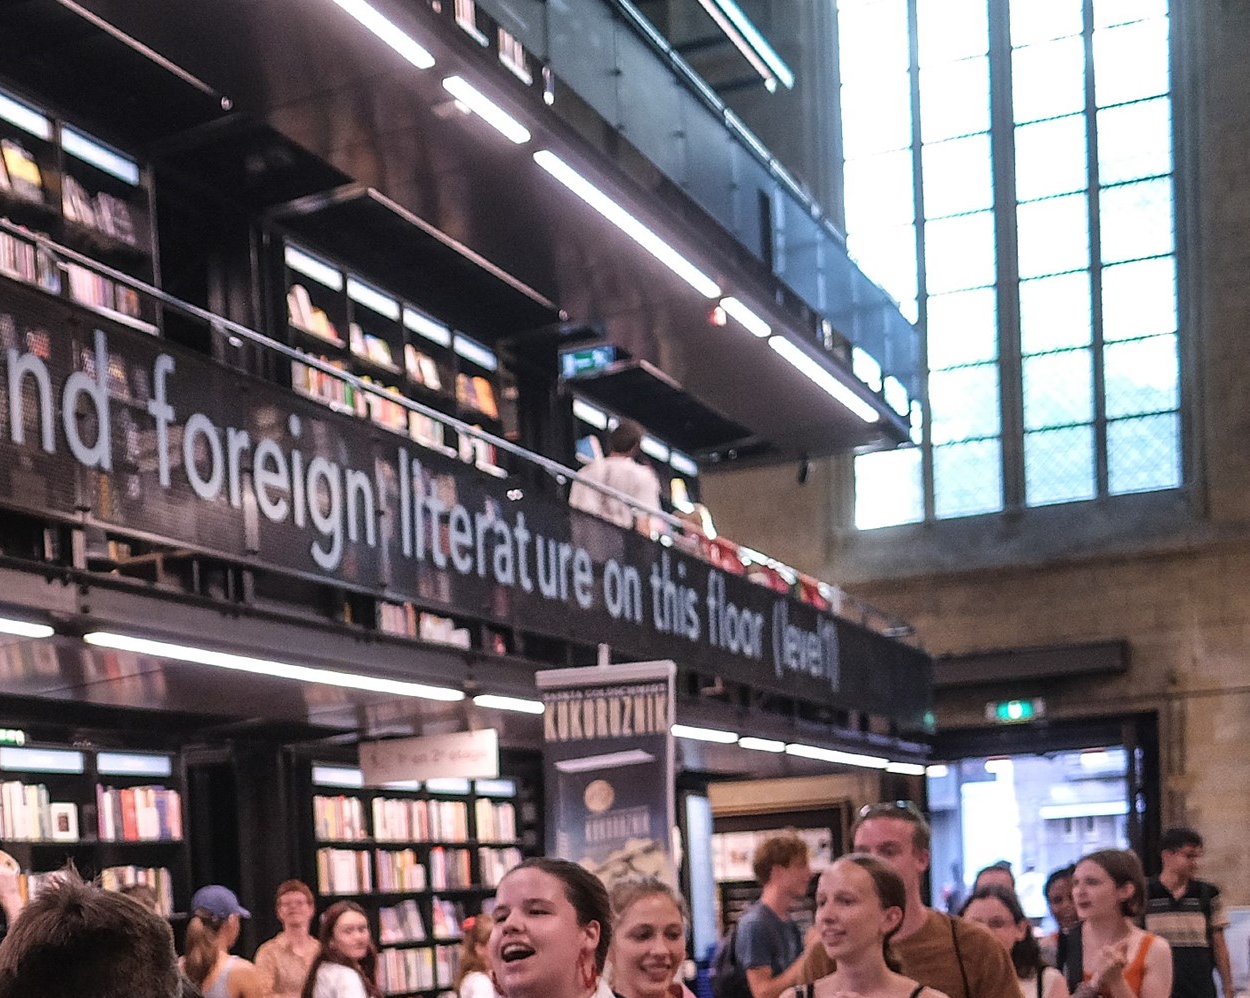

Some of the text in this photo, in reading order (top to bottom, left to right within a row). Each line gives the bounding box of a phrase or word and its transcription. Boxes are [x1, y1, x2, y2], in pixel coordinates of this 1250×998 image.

[148, 353, 377, 571] foreign
[398, 446, 595, 610] literature
[603, 558, 643, 625] on
[651, 550, 700, 642] this
[706, 569, 764, 660] floor
